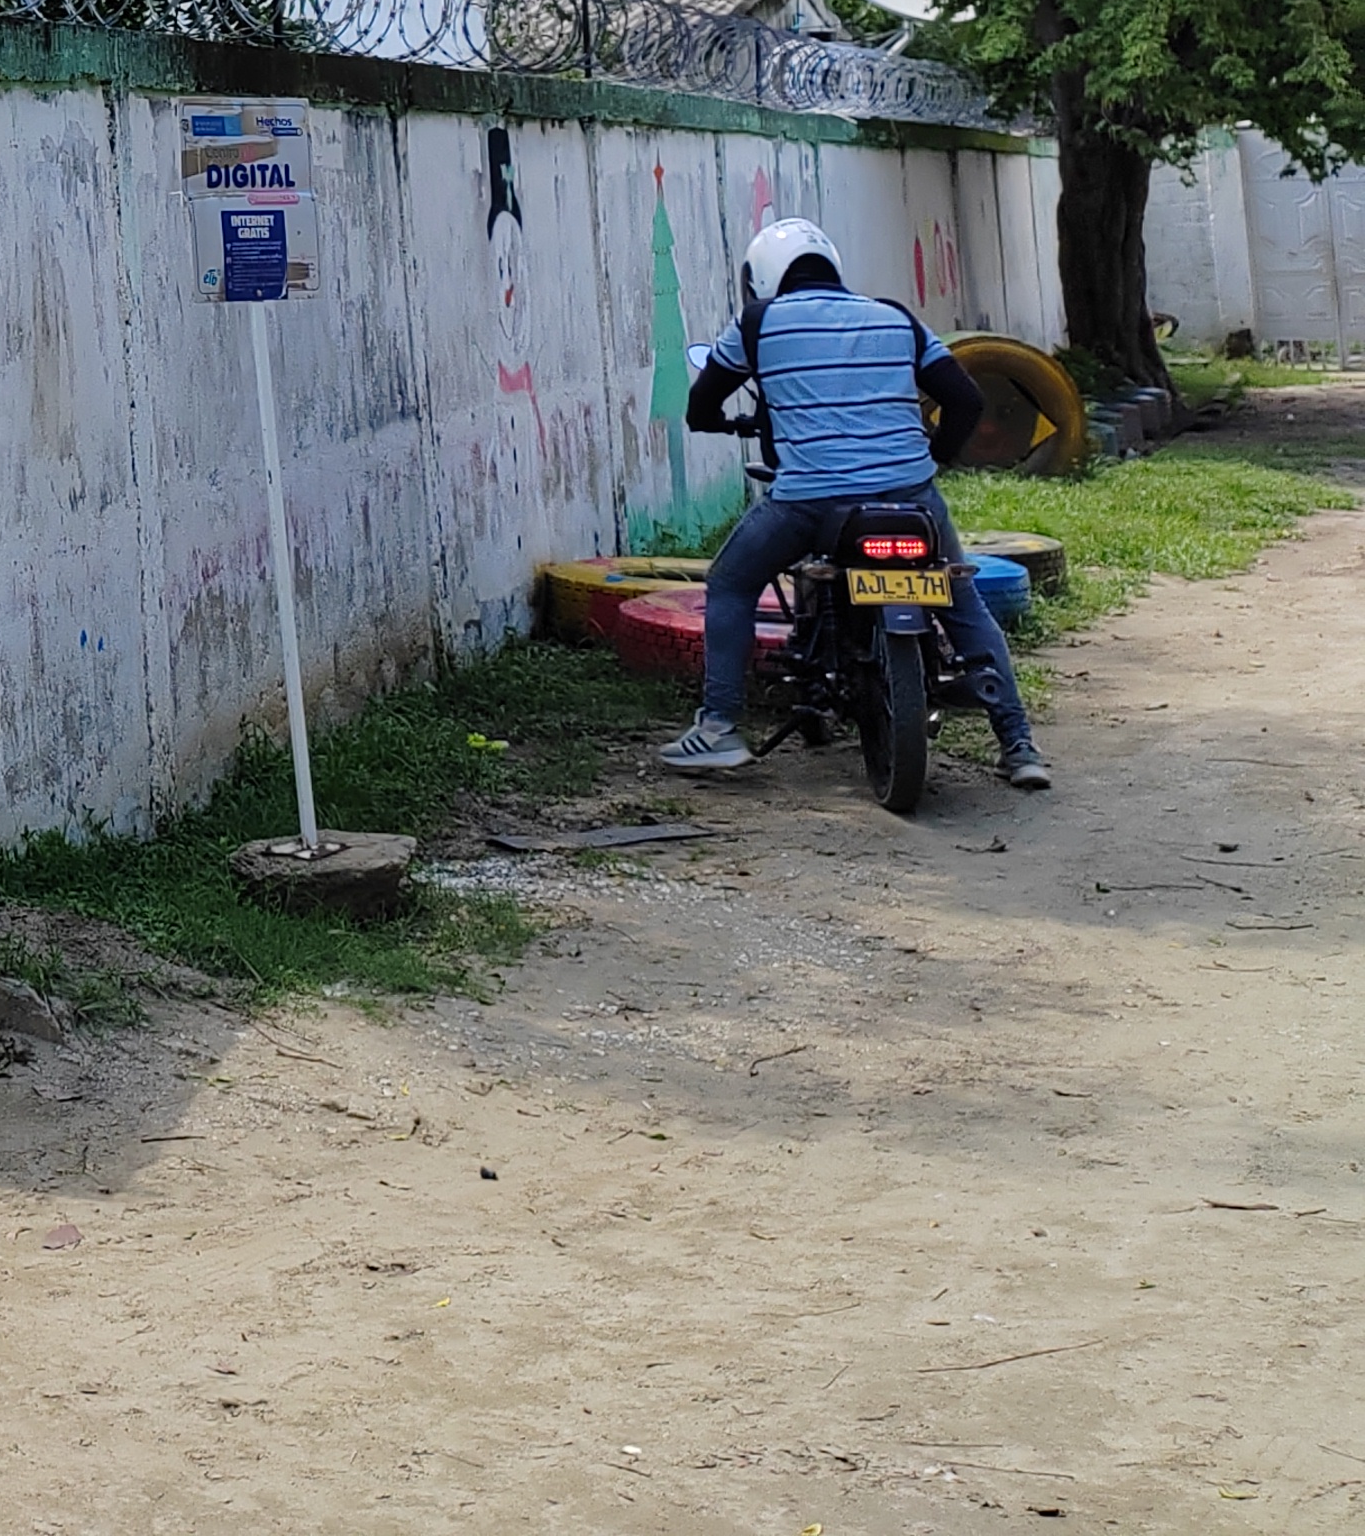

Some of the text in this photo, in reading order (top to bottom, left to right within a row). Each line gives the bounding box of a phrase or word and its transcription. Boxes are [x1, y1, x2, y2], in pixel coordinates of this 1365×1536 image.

[255, 116, 293, 127] Hechos
[206, 163, 296, 189] DIGITAL
[230, 215, 275, 227] INTERNET
[237, 227, 270, 239] GRATIS
